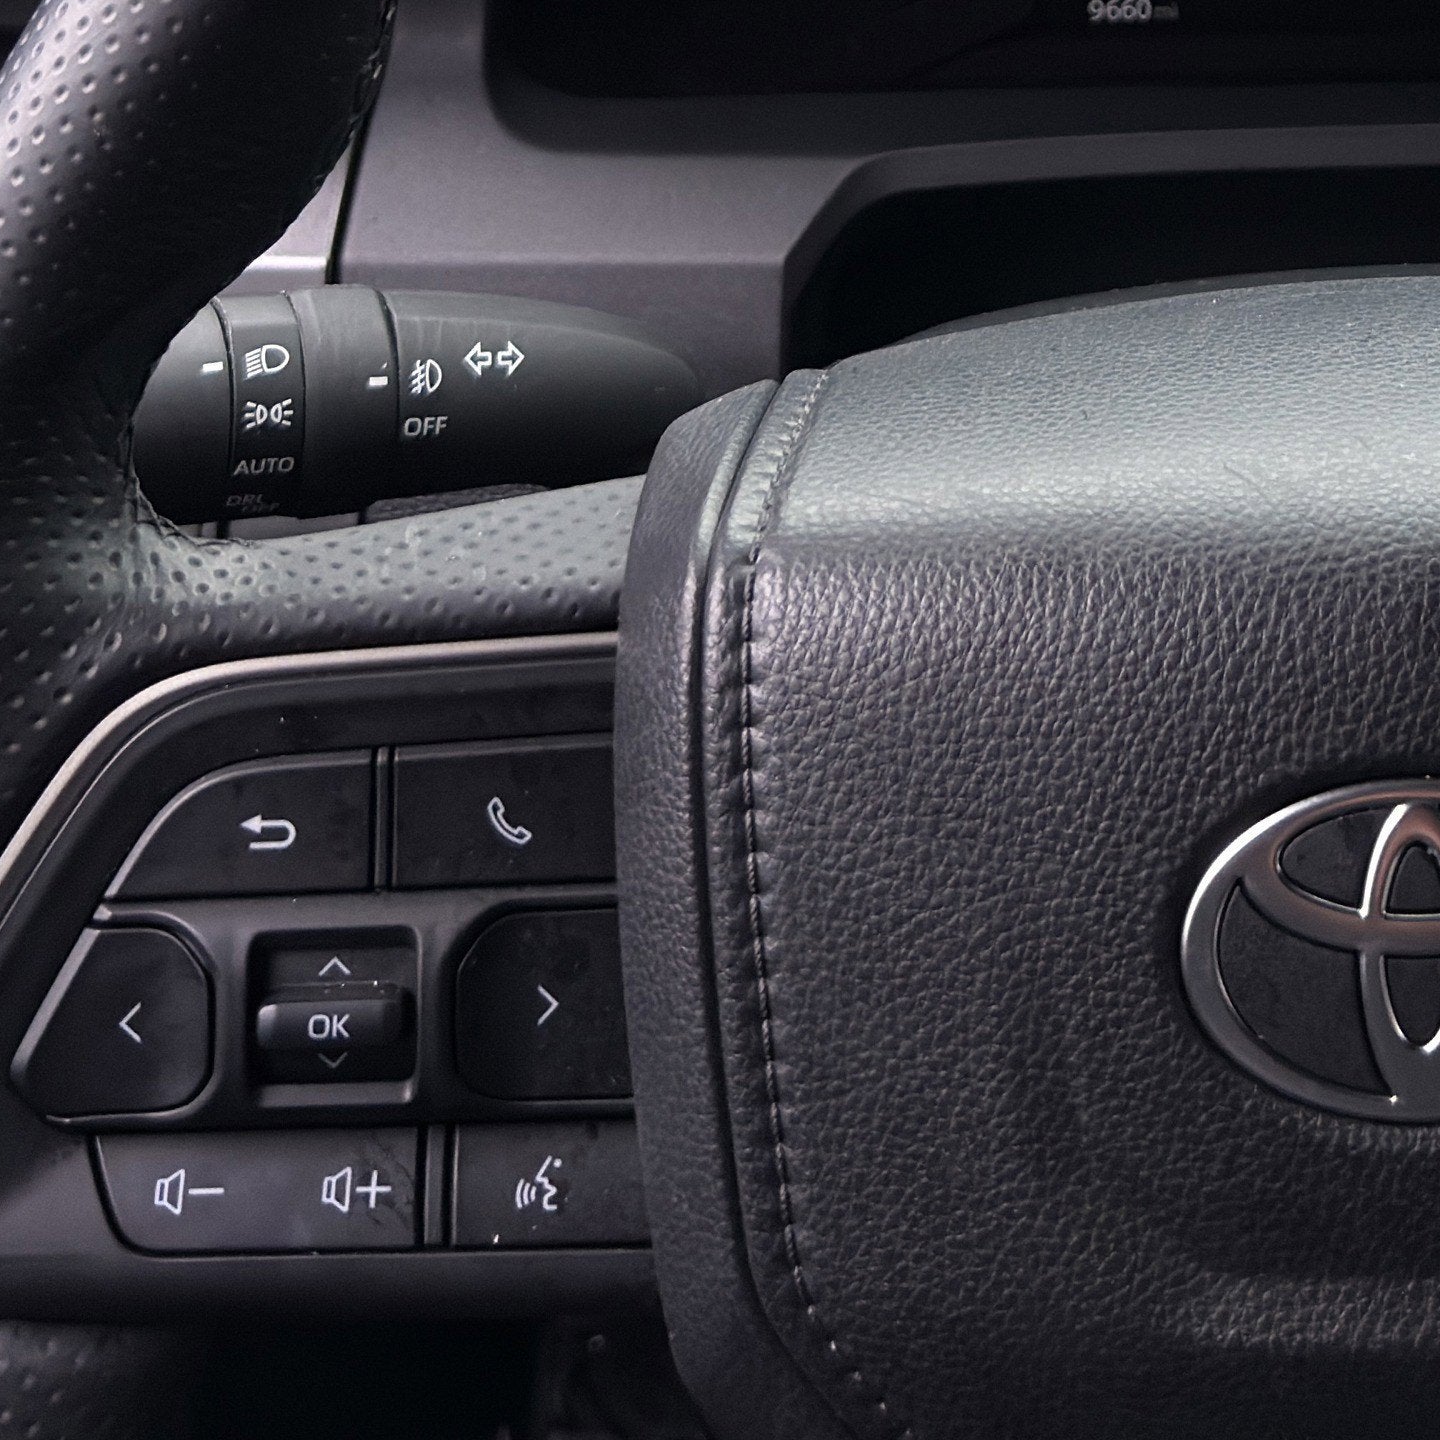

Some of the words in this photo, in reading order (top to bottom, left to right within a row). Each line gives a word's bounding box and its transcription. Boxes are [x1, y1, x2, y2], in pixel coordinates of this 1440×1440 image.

[404, 416, 448, 437] OFF
[233, 457, 295, 476] AUTO
[307, 1012, 350, 1040] OK
